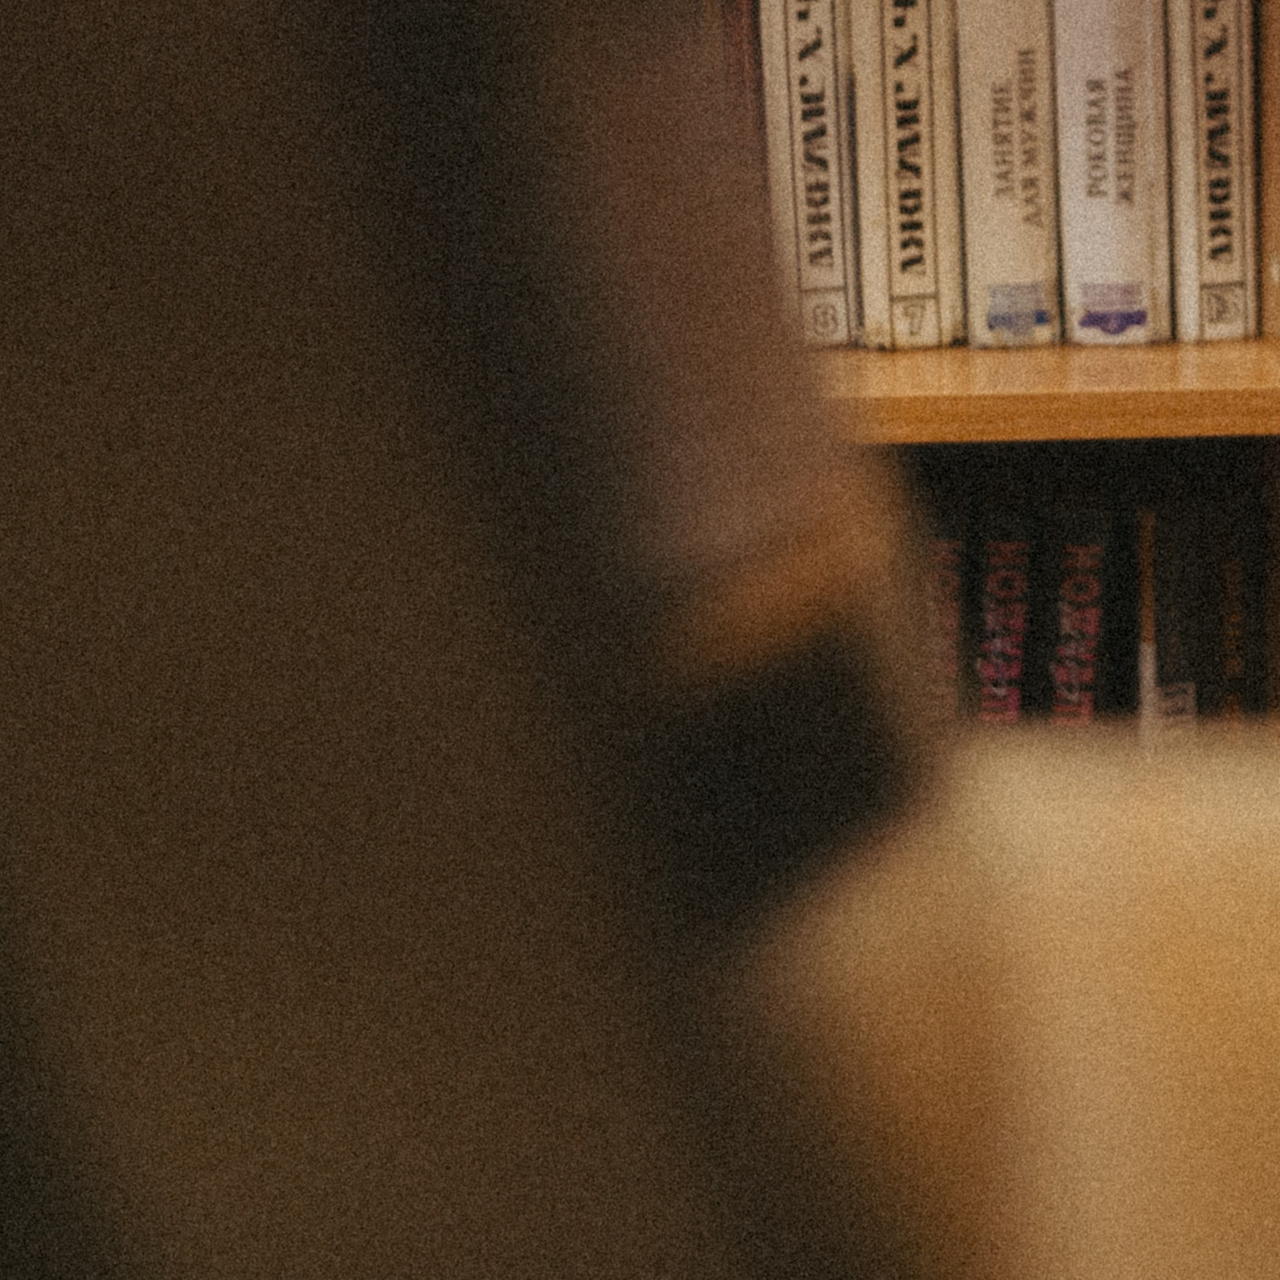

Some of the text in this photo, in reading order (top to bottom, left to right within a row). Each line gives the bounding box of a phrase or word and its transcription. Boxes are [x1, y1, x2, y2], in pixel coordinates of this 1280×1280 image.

[1017, 47, 1040, 168] МУЖЧИН
[1086, 77, 1108, 198] РОКОВАЯ
[1113, 67, 1136, 205] ЖЕНЩИНА
